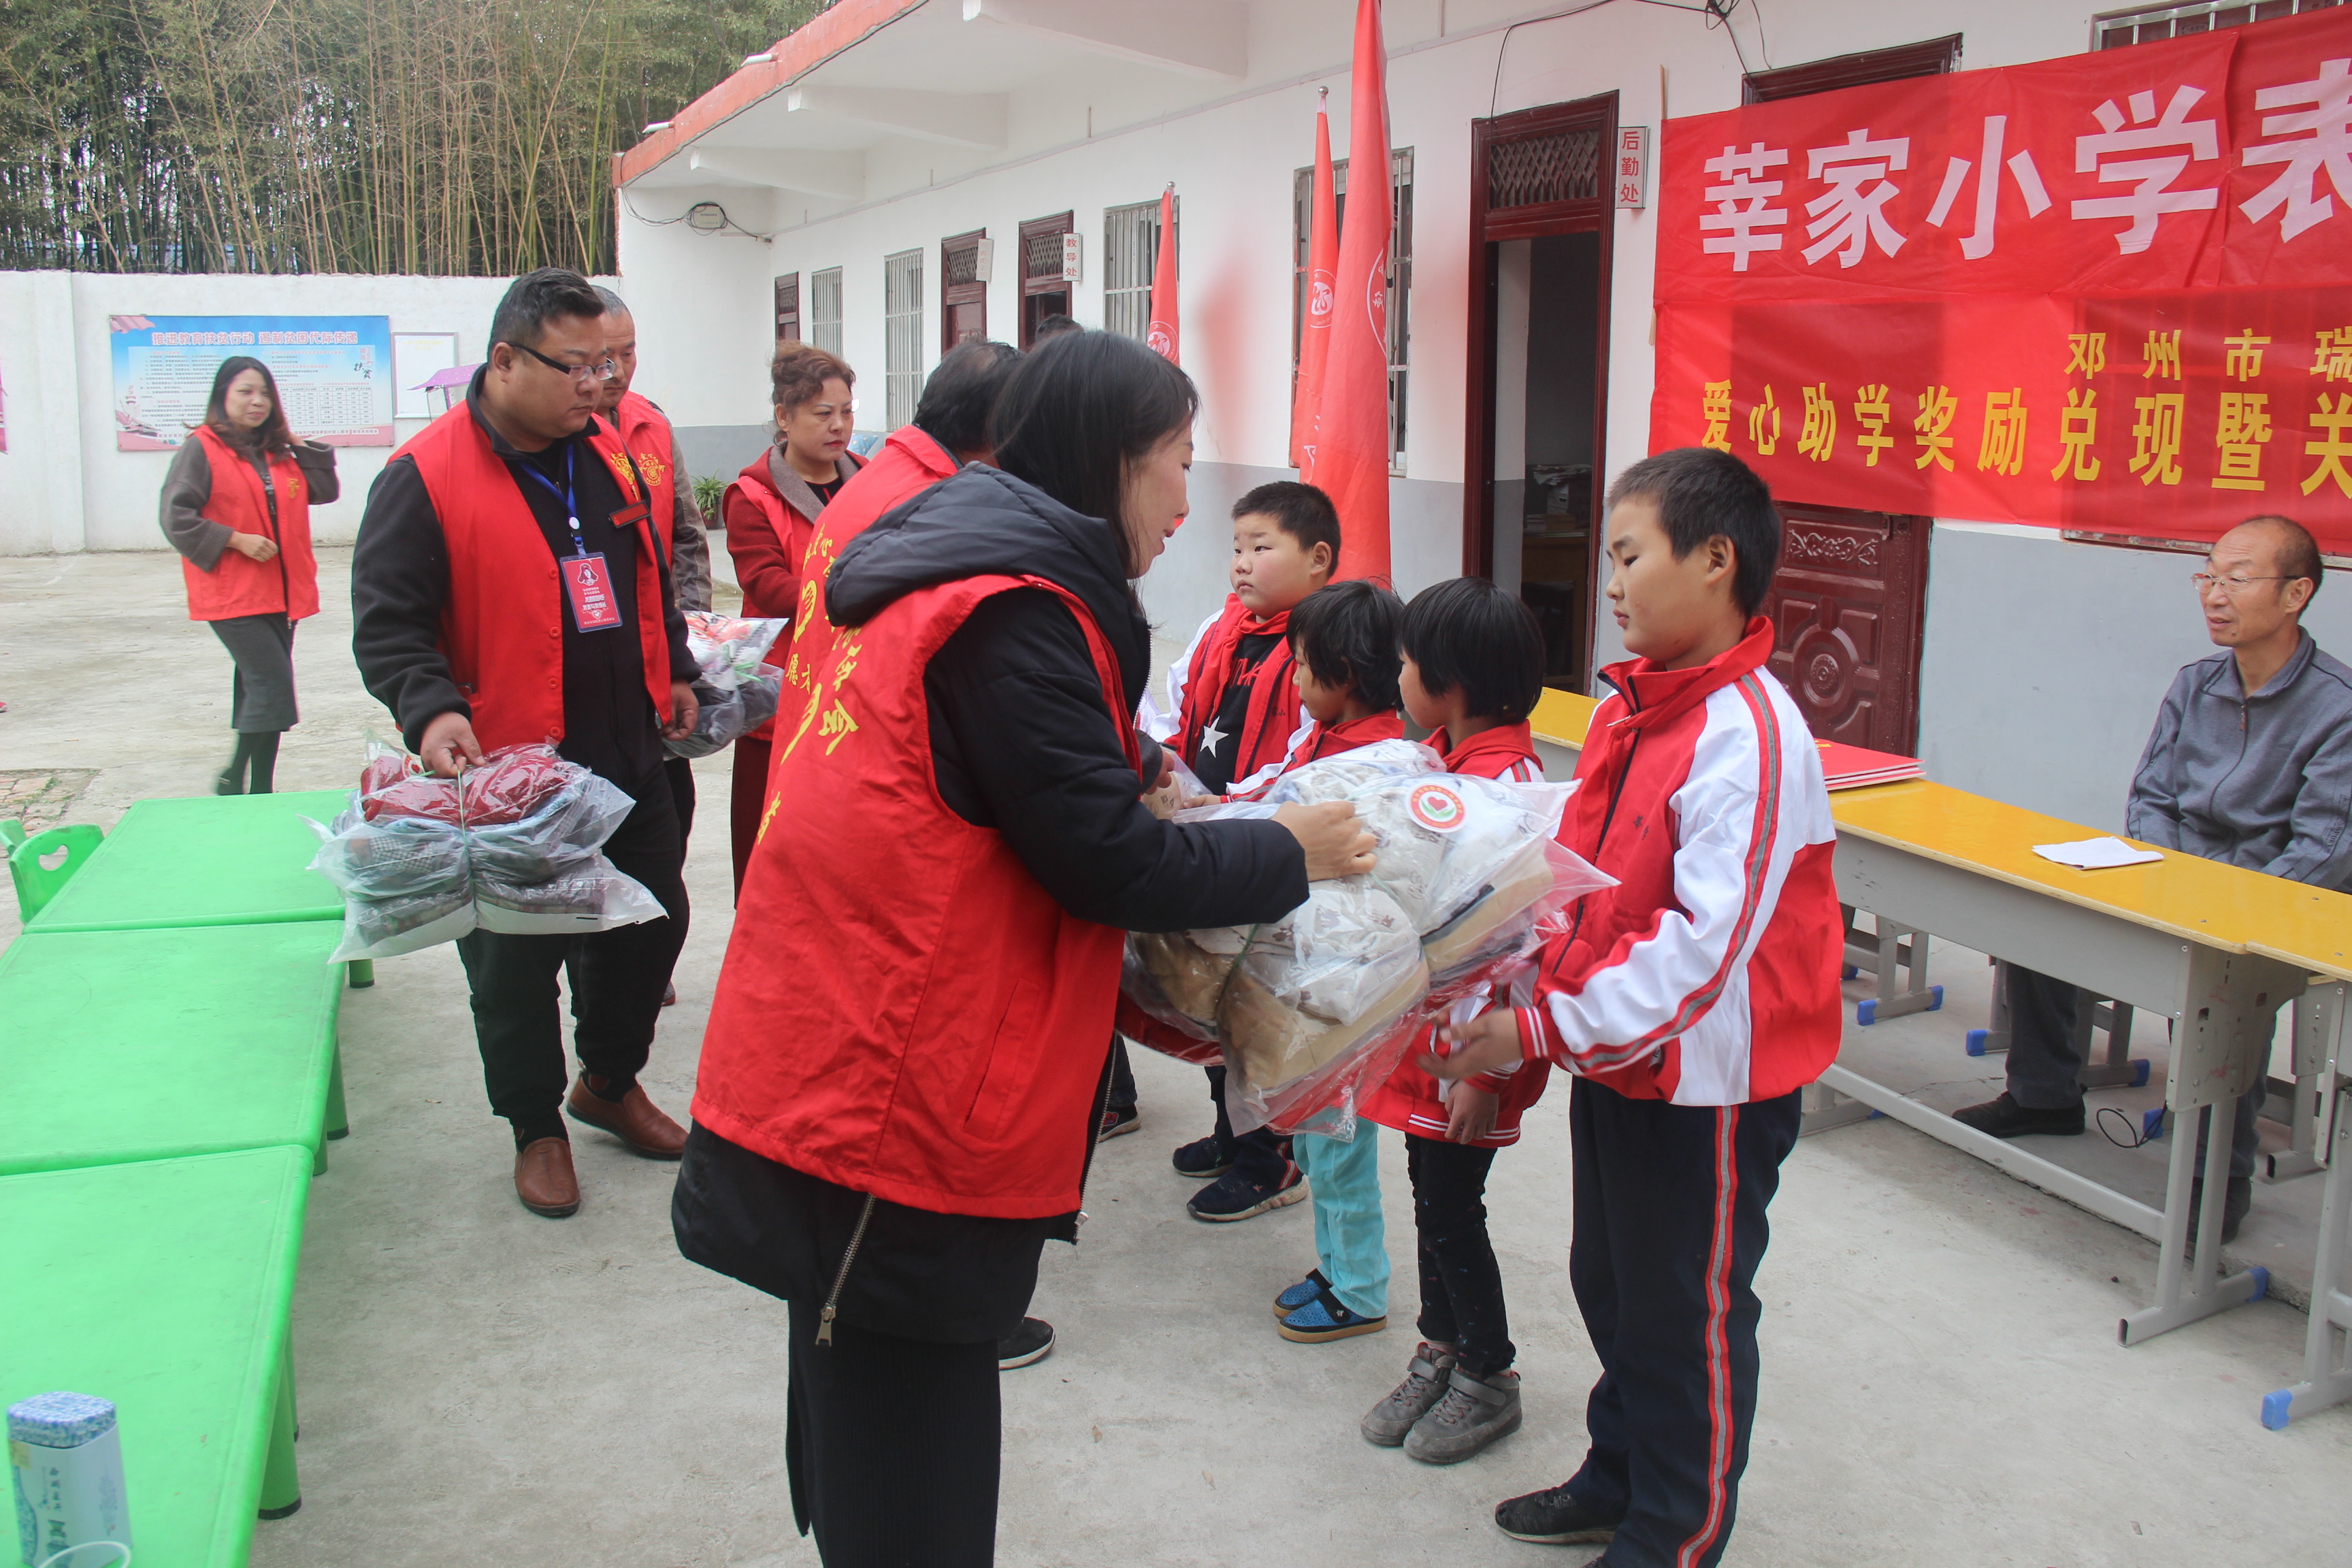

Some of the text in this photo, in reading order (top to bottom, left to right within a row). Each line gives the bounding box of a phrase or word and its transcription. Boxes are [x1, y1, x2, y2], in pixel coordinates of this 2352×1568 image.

[1620, 131, 1639, 202] 后勤处
[1699, 59, 2352, 272] 莘家小学表
[1065, 238, 1077, 276] 教导处
[152, 331, 358, 345] 推进教育扶贫行动 遏制贫困代际传递
[2064, 326, 2352, 382] 邓州市瑞
[1701, 379, 2352, 500] 爱心助学奖励兑现暨关
